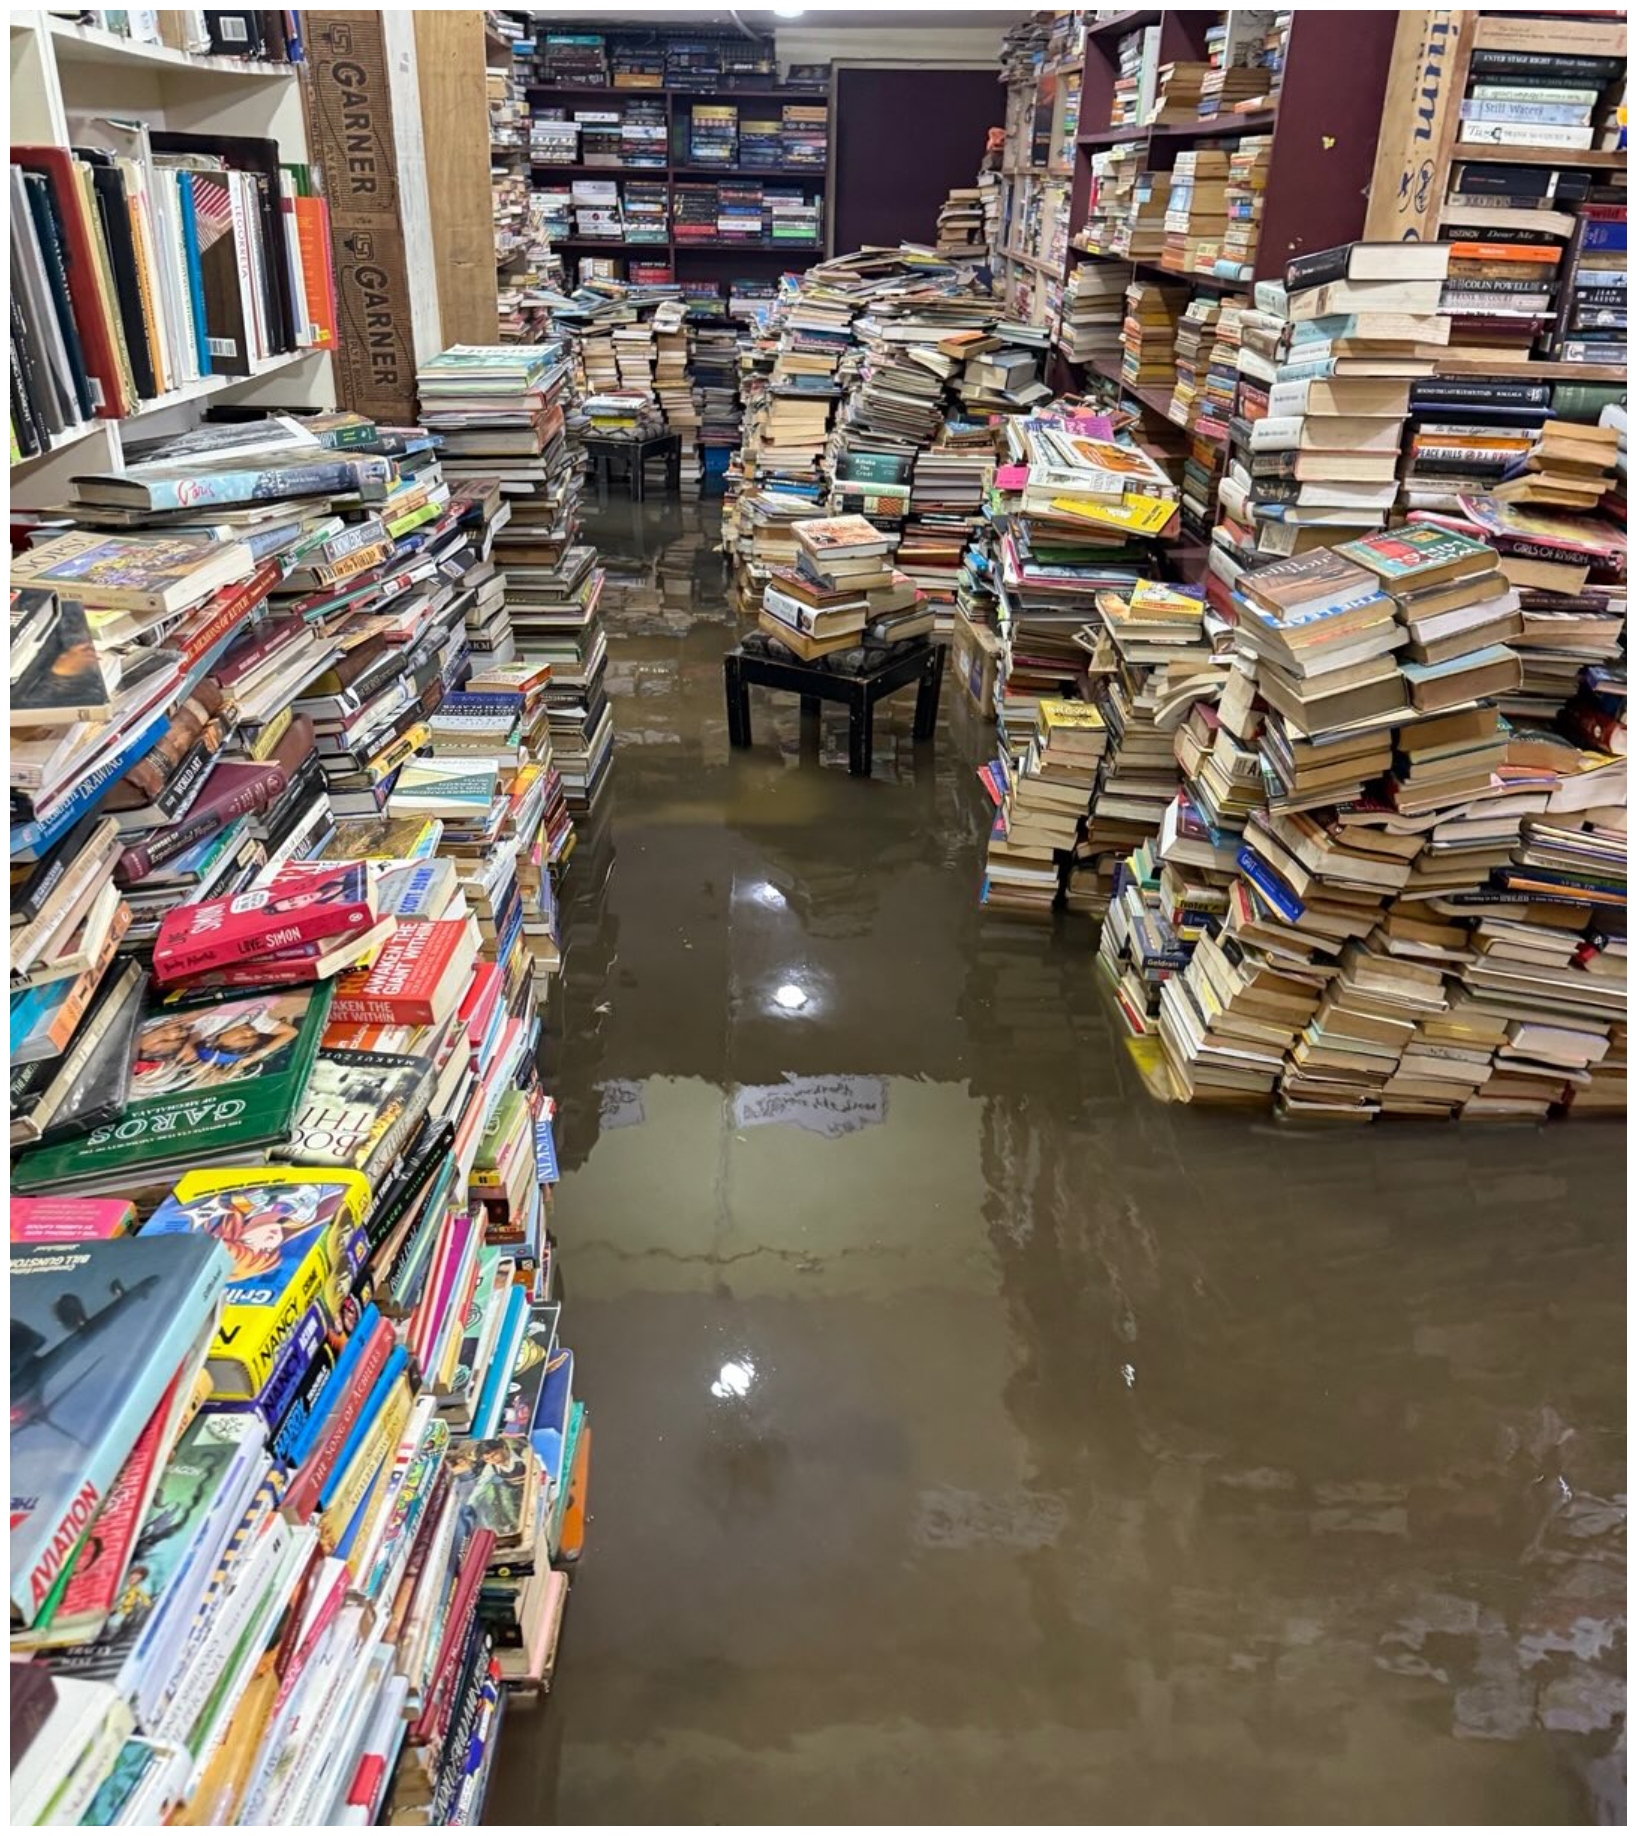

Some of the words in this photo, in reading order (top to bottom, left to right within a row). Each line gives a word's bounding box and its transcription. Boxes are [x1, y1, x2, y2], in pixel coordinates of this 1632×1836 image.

[1413, 10, 1459, 145] ium
[1484, 102, 1505, 113] Still
[332, 61, 377, 195] GARNER
[1487, 230, 1515, 239] Dear
[1517, 231, 1535, 240] Me
[1465, 280, 1493, 290] COLIN
[1494, 281, 1531, 292] POWELL
[355, 266, 398, 387] GARNER
[1441, 450, 1462, 459] KILLS
[178, 478, 216, 505] Paris
[1513, 541, 1540, 555] GIRLS
[1541, 545, 1553, 557] OF
[1247, 560, 1303, 582] delhi
[1339, 592, 1381, 609] THE
[82, 756, 125, 799] DRAWING
[174, 768, 194, 796] WORLD
[148, 836, 171, 854] METHODS
[150, 831, 194, 864] Experimental
[399, 886, 420, 913] SCOTT
[265, 928, 302, 948] SIMON
[365, 943, 402, 995] AWAKEN
[384, 958, 408, 997] GIANT
[406, 921, 436, 959] WITHIN
[330, 1001, 365, 1014] AKEN
[367, 1001, 392, 1014] THE
[350, 1012, 395, 1023] WITHIN
[356, 1055, 415, 1067] MARKUS
[87, 1099, 246, 1145] GAROS
[536, 1121, 554, 1179] RUSKIN
[377, 1205, 402, 1237] PLACES
[65, 1254, 91, 1266] BILL
[259, 1299, 301, 1366] NANCY
[324, 1422, 350, 1463] SONG
[353, 1349, 382, 1402] ACHILLES
[30, 1481, 99, 1605] AVIATION
